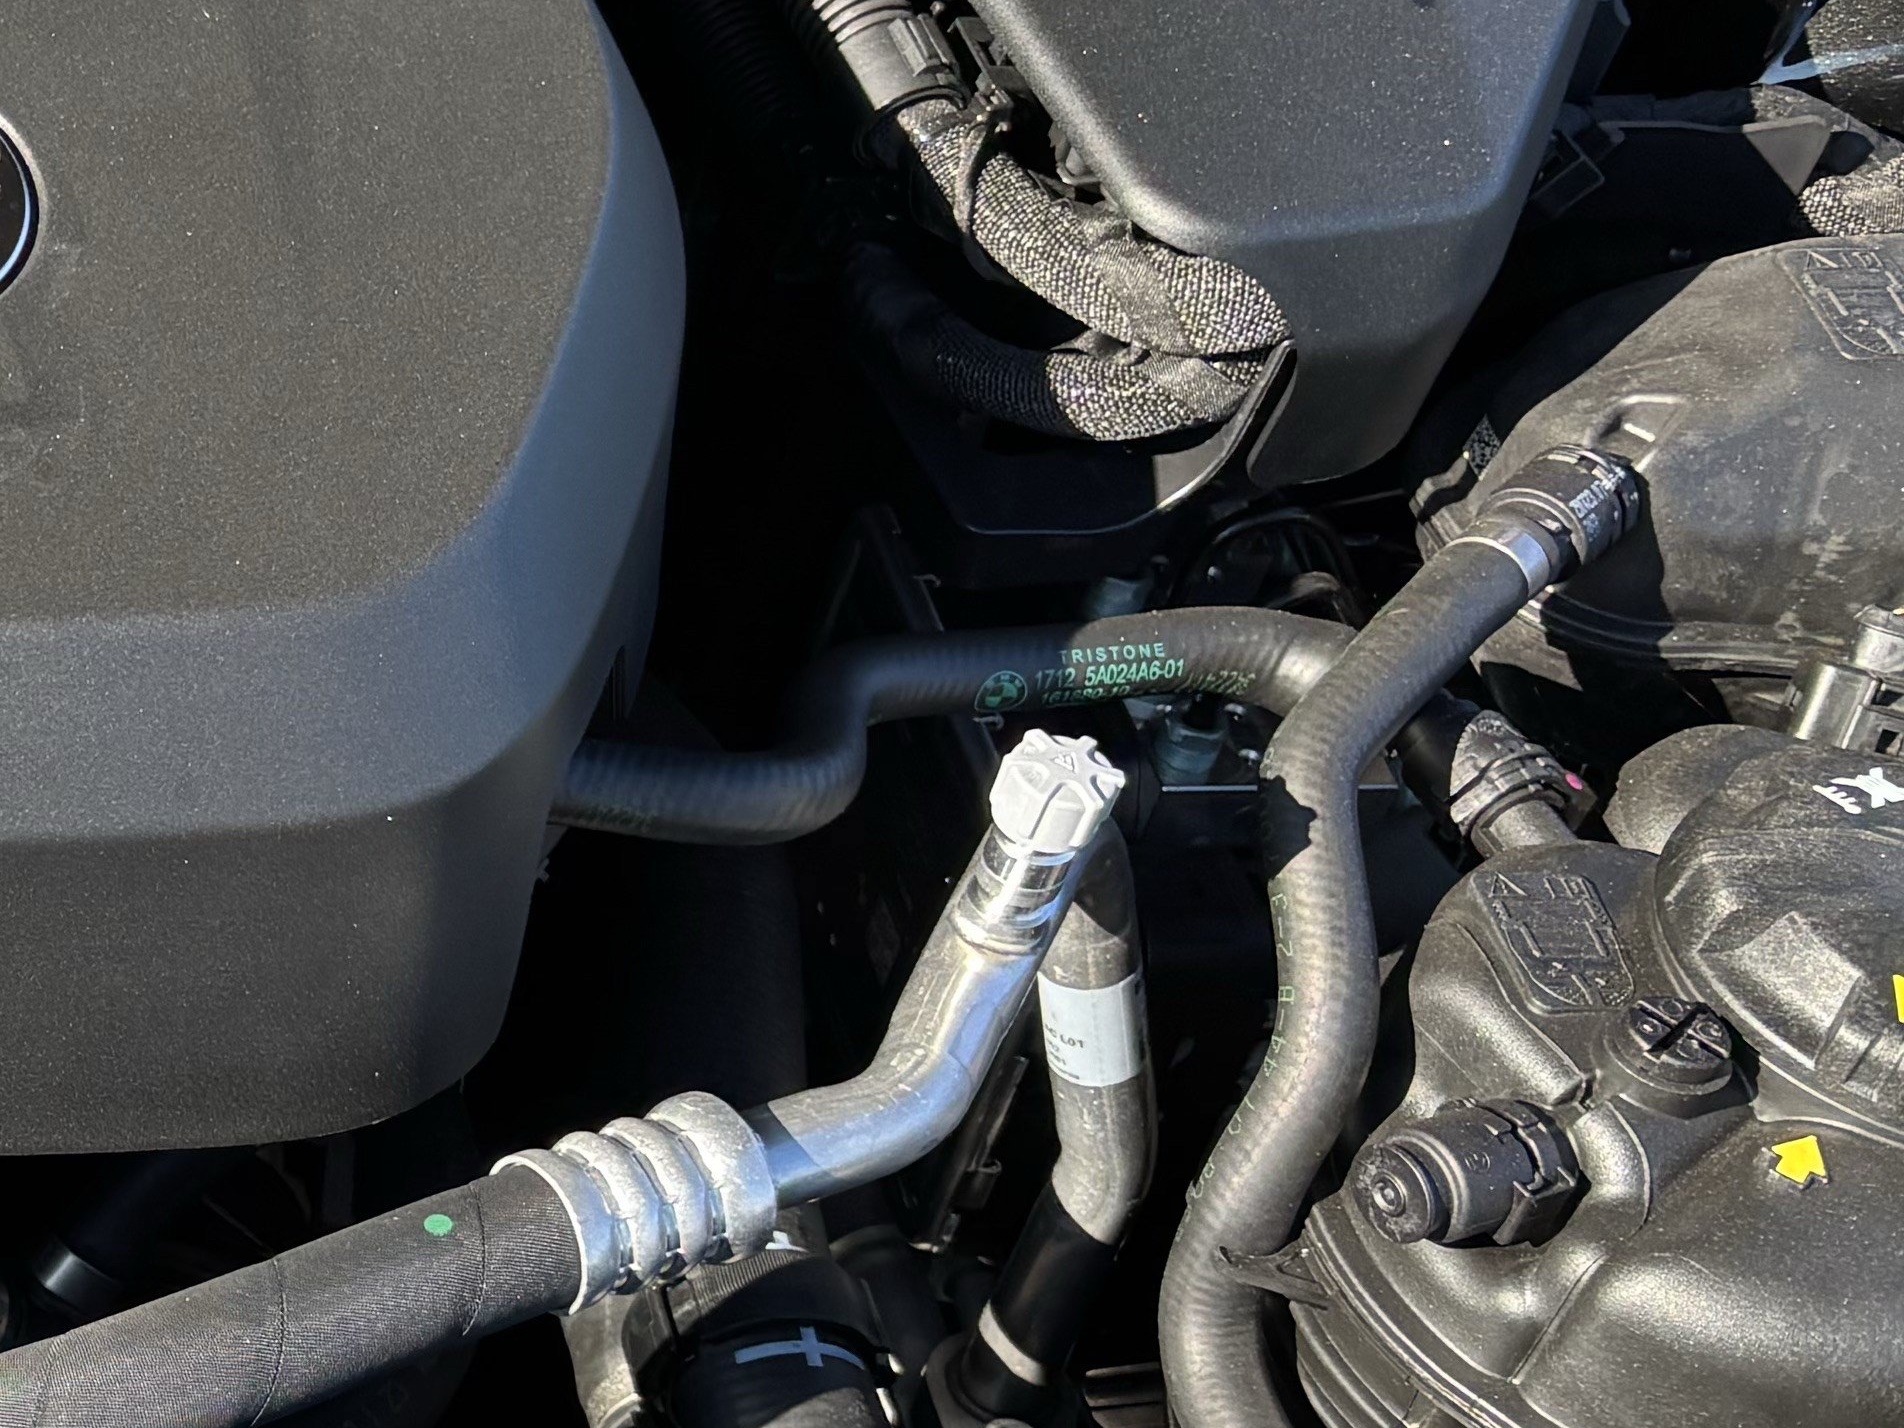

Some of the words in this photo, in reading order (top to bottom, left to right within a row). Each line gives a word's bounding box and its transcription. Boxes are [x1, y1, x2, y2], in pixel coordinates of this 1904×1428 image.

[1058, 642, 1167, 665] TRISTONE
[1034, 668, 1076, 689] 1712
[1083, 658, 1186, 687] 5A024A6-01
